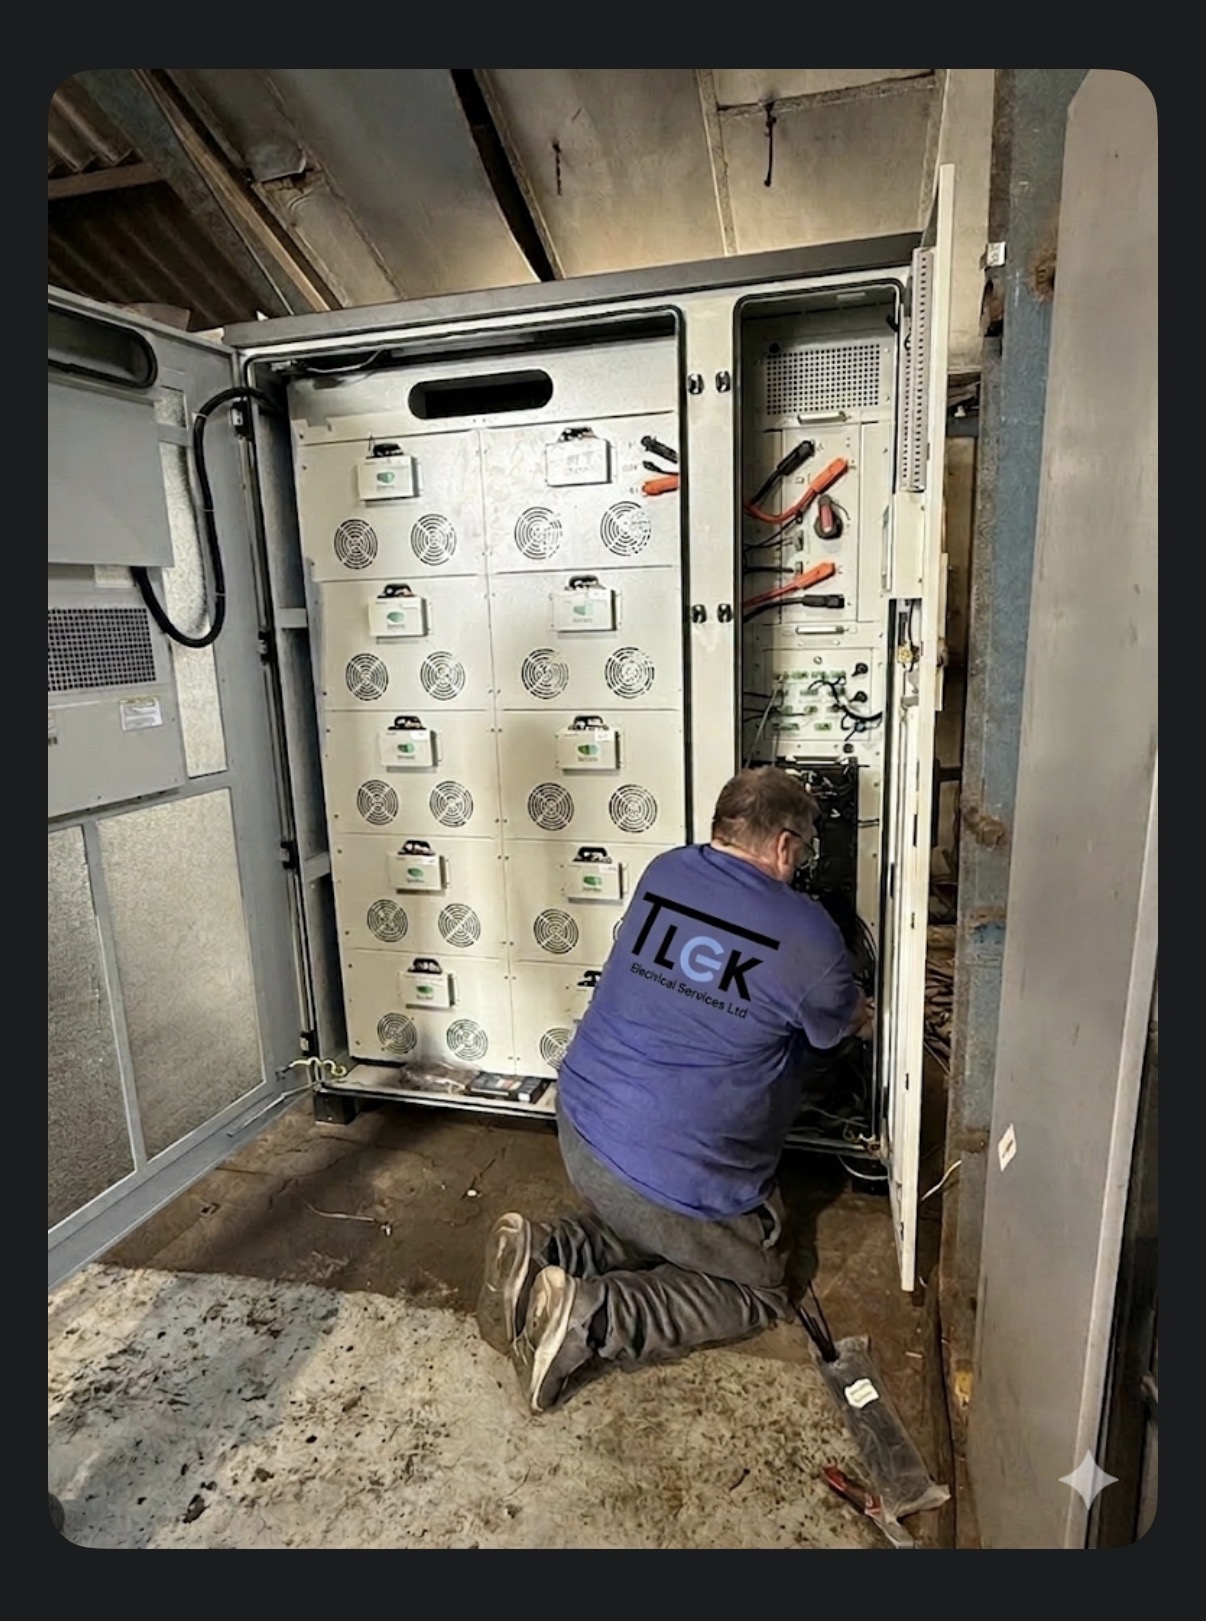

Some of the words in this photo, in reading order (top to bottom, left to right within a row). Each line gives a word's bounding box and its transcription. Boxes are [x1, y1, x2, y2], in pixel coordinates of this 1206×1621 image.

[630, 962, 677, 990] Electrical
[677, 983, 729, 1011] Services
[727, 1002, 748, 1019] Ltd
